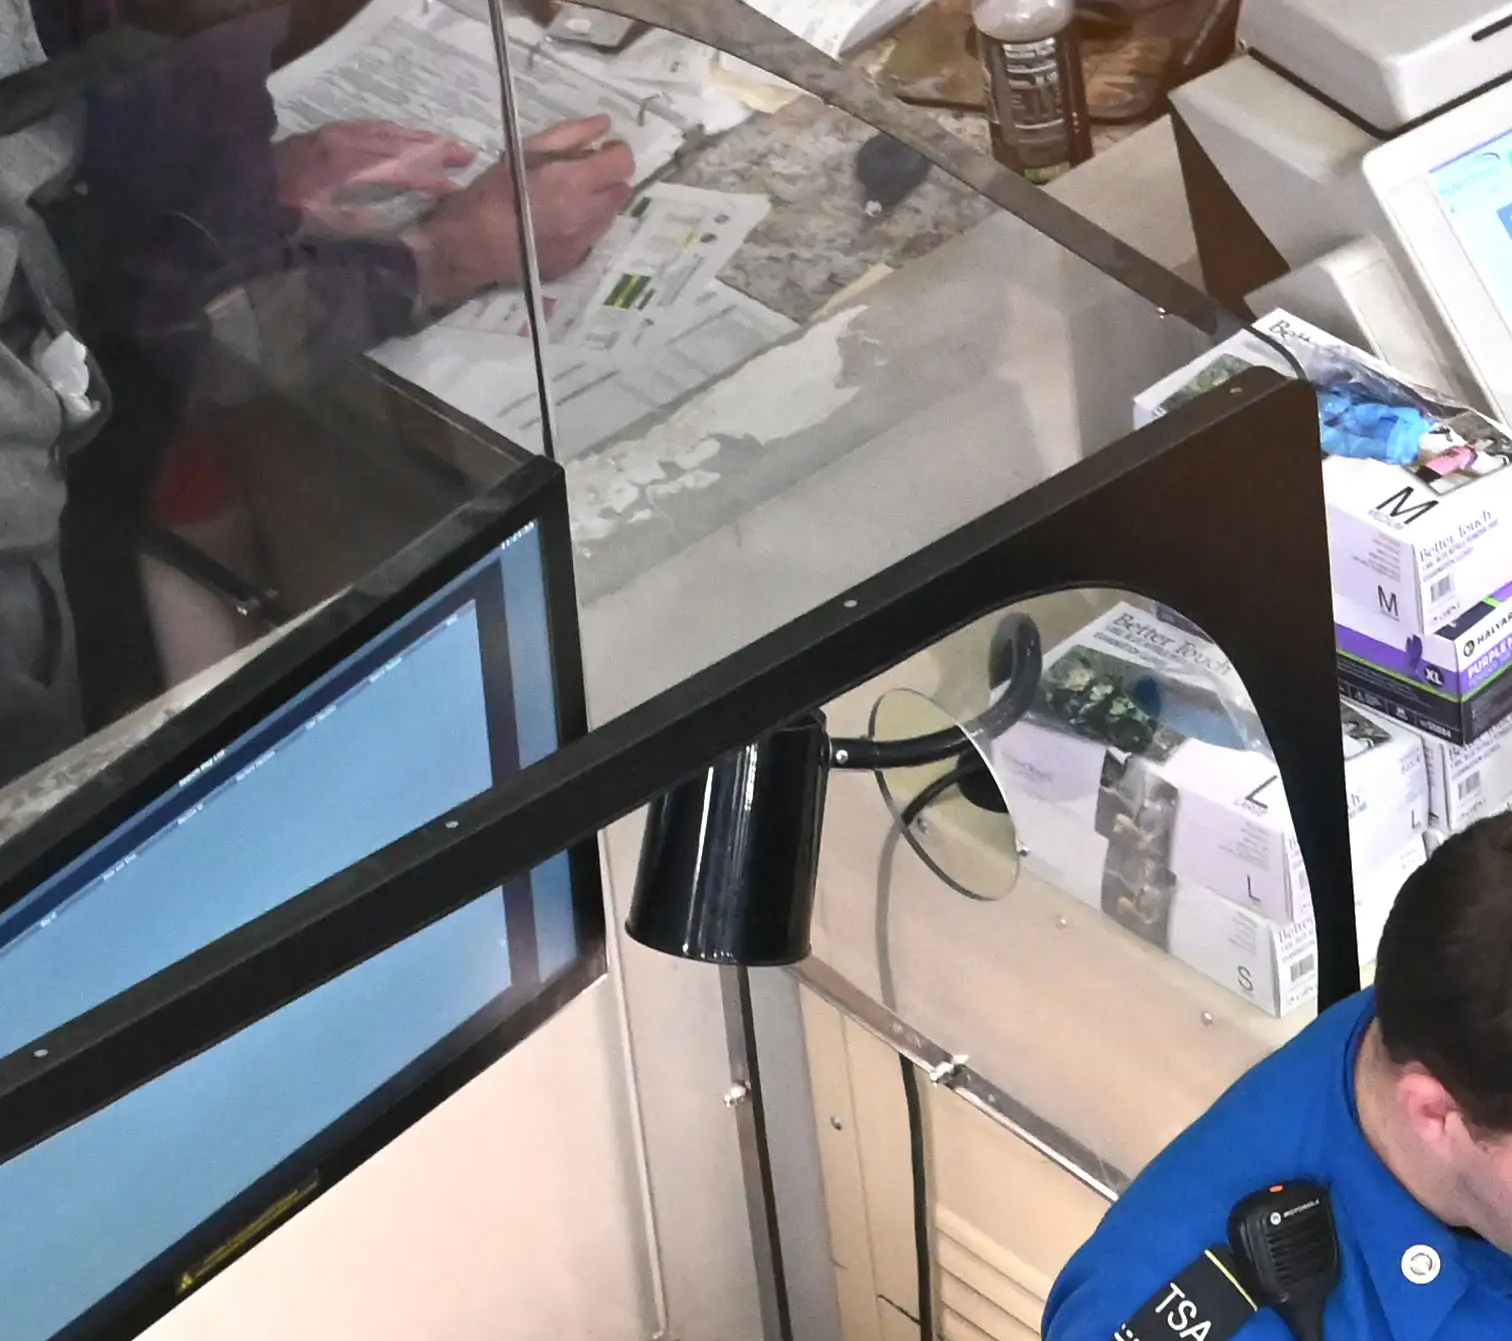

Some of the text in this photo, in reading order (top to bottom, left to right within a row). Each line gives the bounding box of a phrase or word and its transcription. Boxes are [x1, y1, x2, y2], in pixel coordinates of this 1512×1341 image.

[1376, 486, 1439, 525] M
[1377, 585, 1400, 618] M
[1113, 612, 1175, 647] Better
[1174, 641, 1233, 676] Touch
[1467, 638, 1507, 679] PURPLE
[1424, 668, 1444, 686] XL
[1245, 775, 1279, 809] L
[1246, 874, 1261, 902] L
[1237, 965, 1254, 992] S
